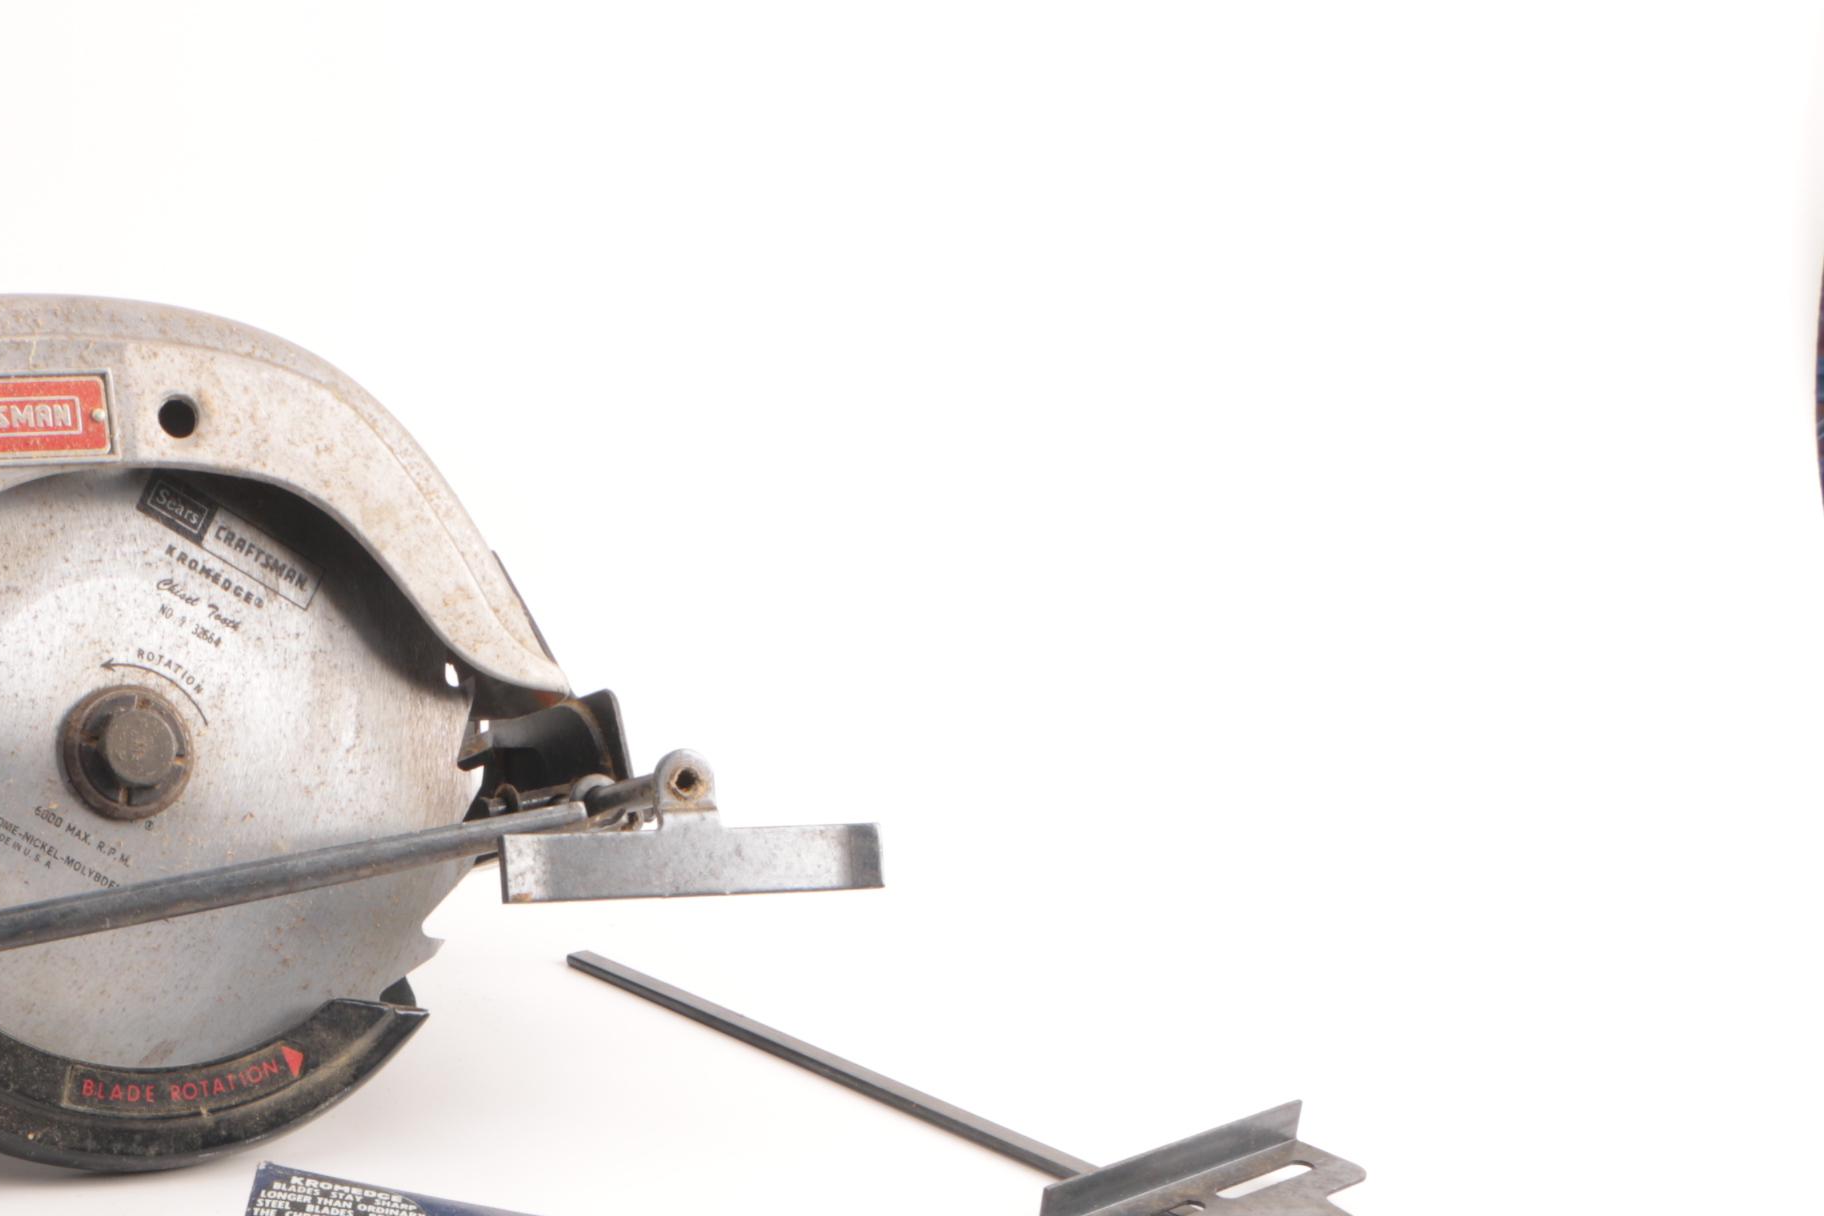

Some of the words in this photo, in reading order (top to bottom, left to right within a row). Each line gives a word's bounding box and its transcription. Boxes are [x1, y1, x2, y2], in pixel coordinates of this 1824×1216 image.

[155, 489, 200, 525] Sears
[215, 525, 308, 593] CRAFTSMAN
[156, 579, 199, 607] Chisel
[208, 603, 242, 631] Tooth
[136, 649, 205, 695] ROTATION
[12, 840, 23, 852] IN
[82, 1079, 156, 1103] BLADE
[169, 1060, 280, 1101] ROTATION
[260, 1189, 312, 1203] LONGER
[317, 1196, 352, 1209] THAN
[273, 1182, 320, 1196] BLADES
[330, 1191, 363, 1202] STAY
[374, 1198, 417, 1210] SHARP
[290, 1176, 402, 1202] KROMEDGE
[256, 1198, 291, 1210] STEEL
[305, 1204, 353, 1216] BLADES
